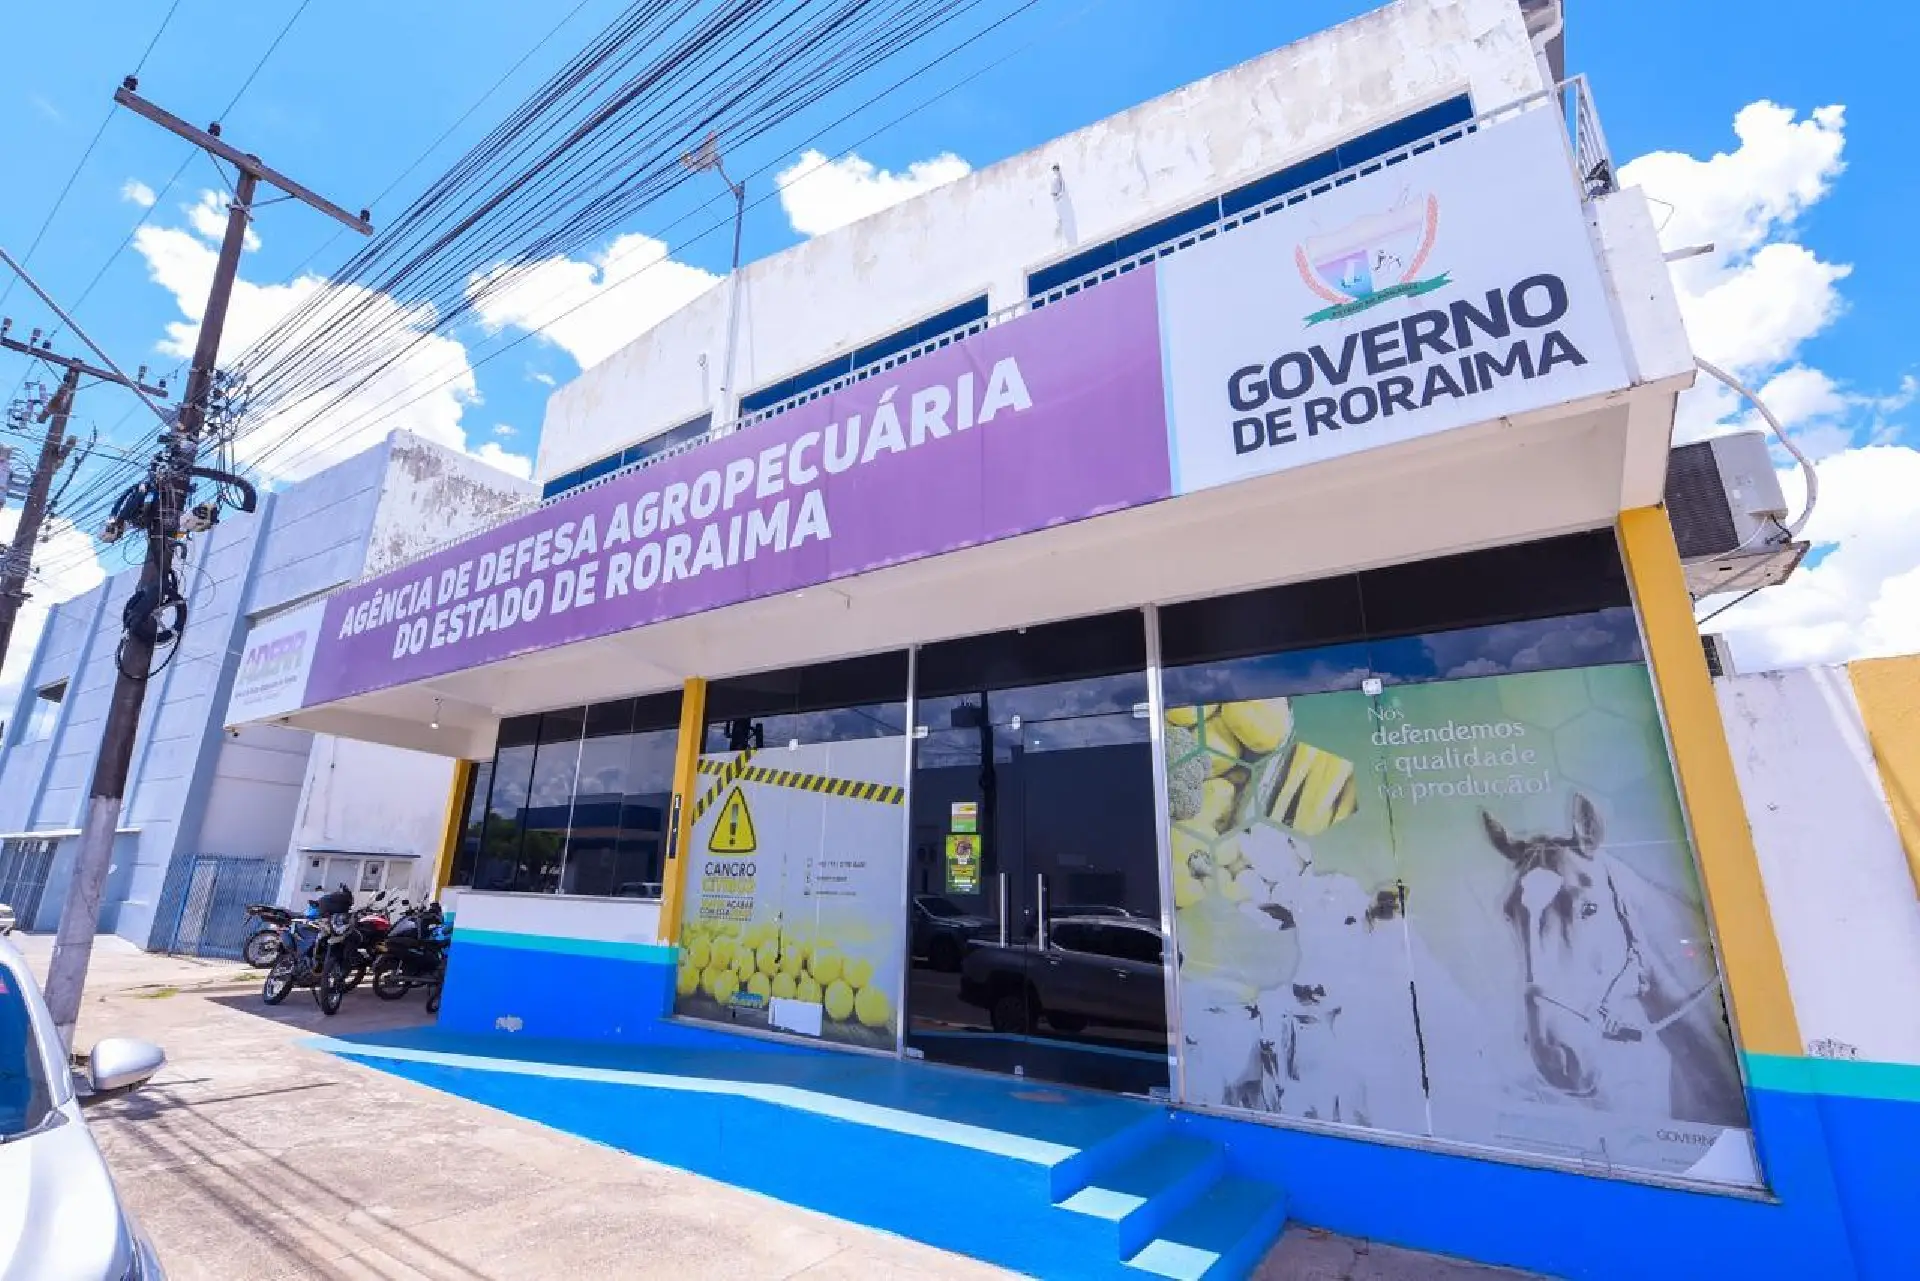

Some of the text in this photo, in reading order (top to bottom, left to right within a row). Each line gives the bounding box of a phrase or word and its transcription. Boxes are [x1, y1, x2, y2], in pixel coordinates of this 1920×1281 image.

[1227, 273, 1570, 412] GOVERNO
[1232, 330, 1589, 455] DE RORAIMA
[338, 356, 1033, 640] AGÊNCIA DE DEFESA AGROPECUÁRIA
[392, 489, 832, 660] DO ESTADO DE RORAIMA
[1371, 720, 1525, 746] defendemos
[1395, 744, 1537, 778] qualidade
[1411, 770, 1553, 805] produção!
[704, 862, 757, 877] CANCRO
